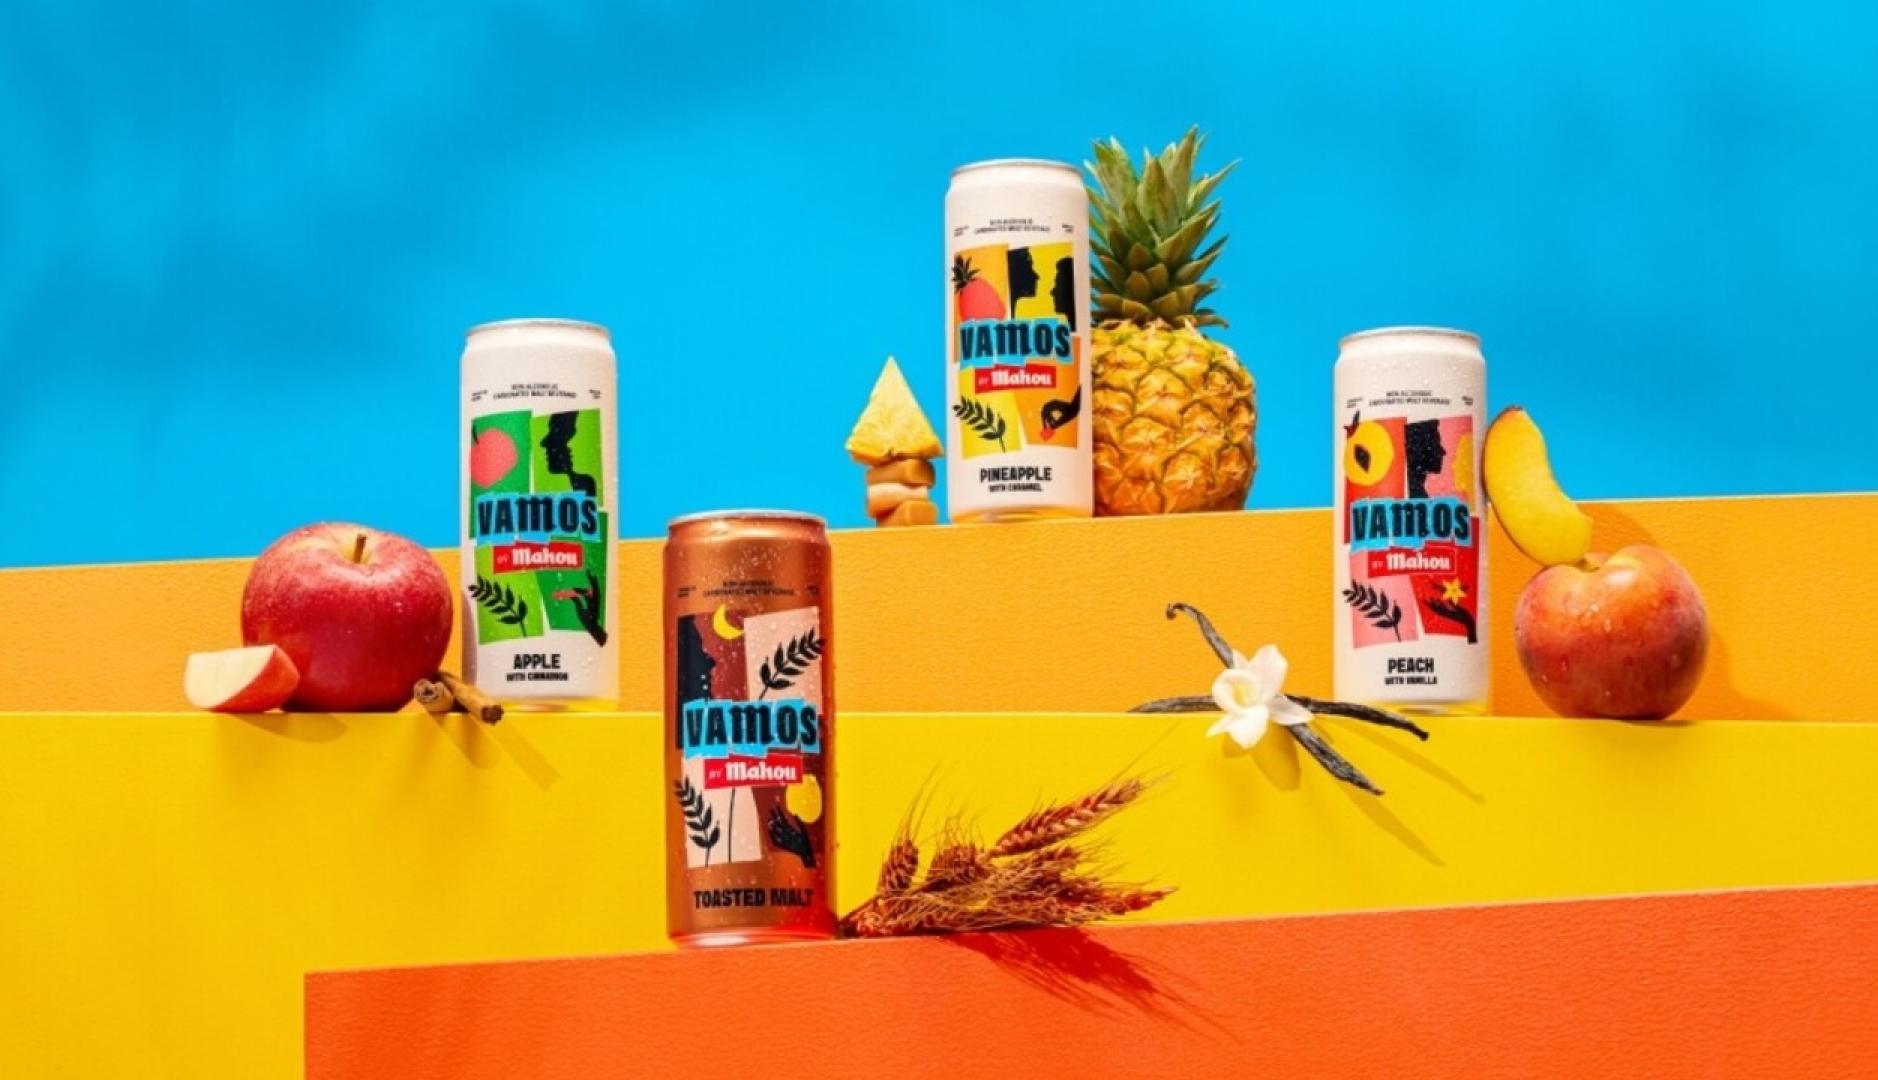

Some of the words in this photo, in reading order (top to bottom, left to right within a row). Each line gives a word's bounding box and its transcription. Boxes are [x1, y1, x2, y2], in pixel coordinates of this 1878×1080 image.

[960, 323, 1071, 360] VAMOS
[991, 369, 1052, 387] Mahou
[980, 466, 1052, 482] PINEAPPLE
[478, 497, 598, 535] VAMOS
[1353, 503, 1470, 540] VAMOS
[512, 547, 578, 566] Mahou
[1386, 552, 1450, 570] Mahou
[513, 653, 561, 670] APPLE
[1387, 657, 1435, 673] PEACH
[686, 704, 817, 747] VAMOS
[725, 761, 797, 781] Mahou
[693, 888, 766, 909] TOASTED
[770, 888, 814, 907] MALT
